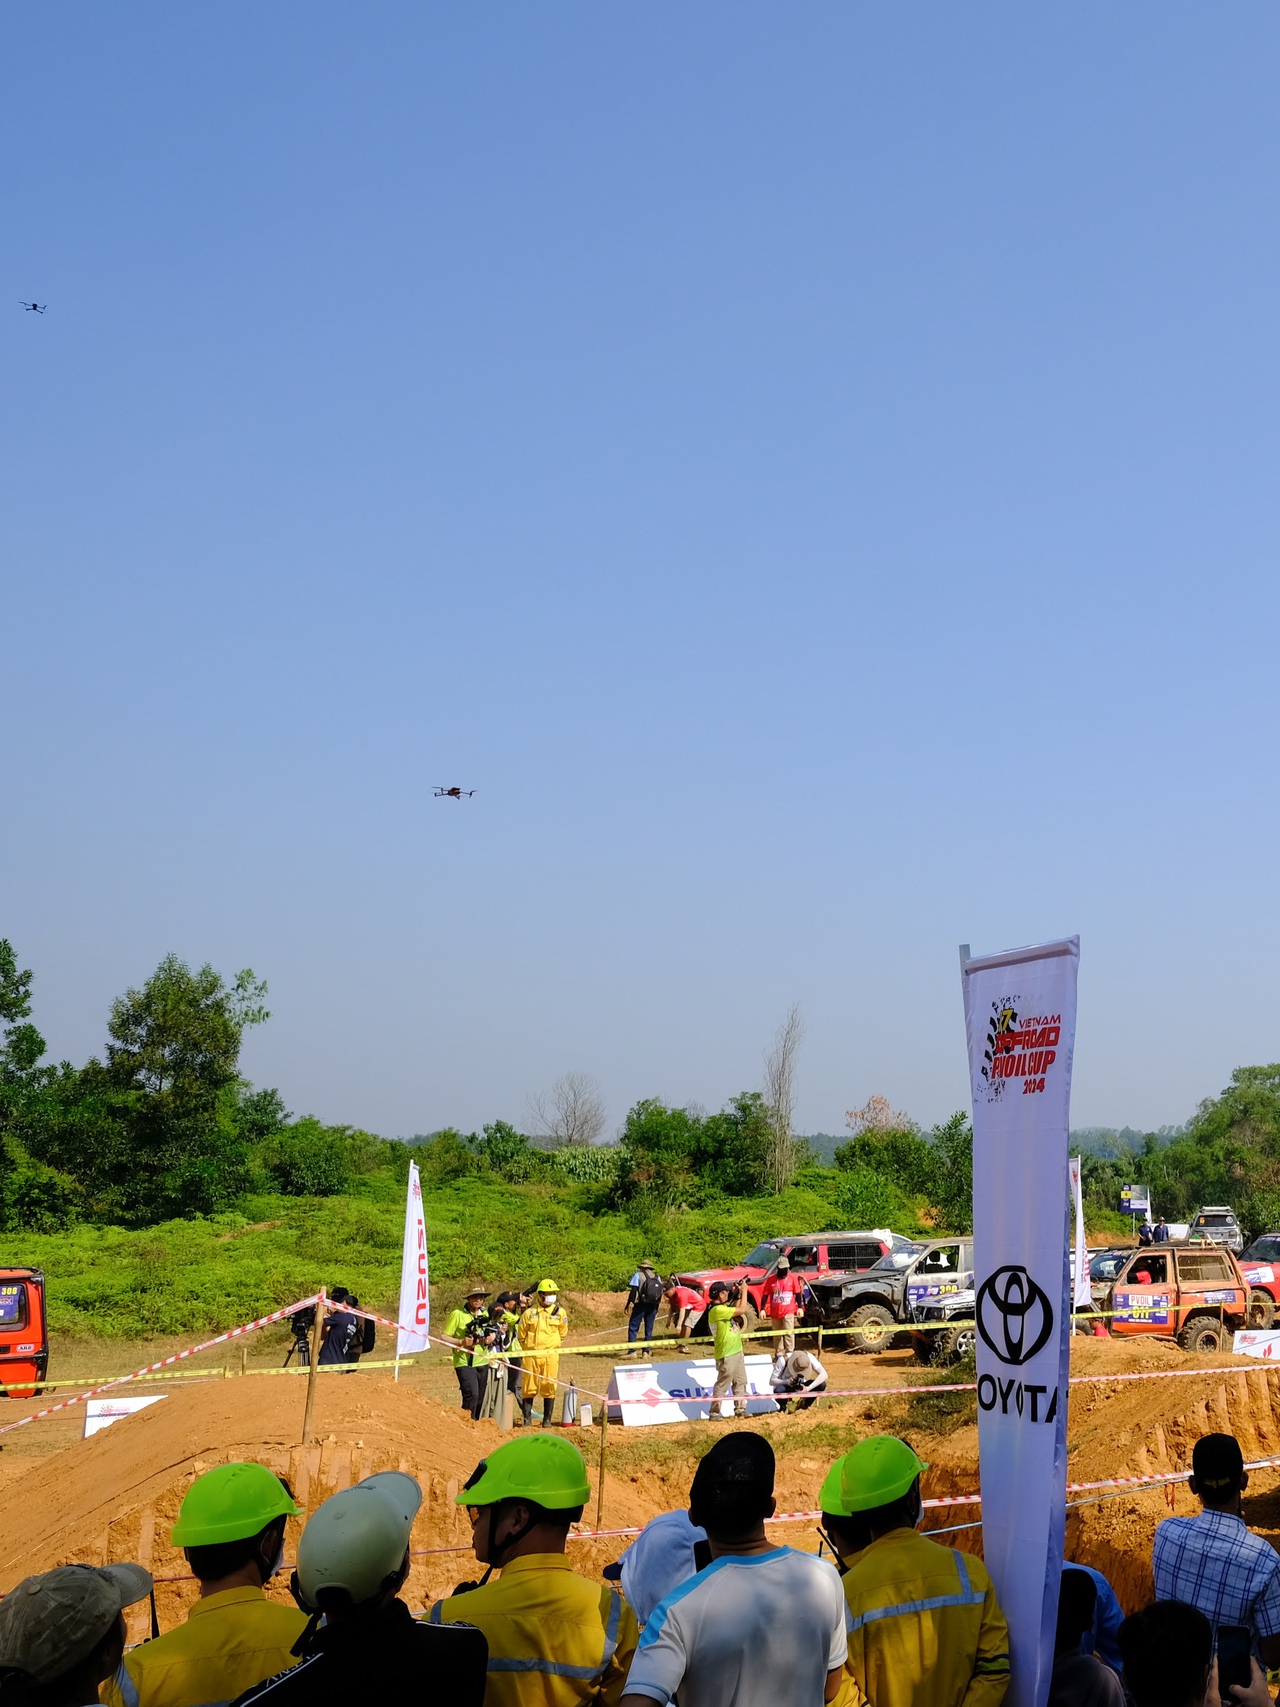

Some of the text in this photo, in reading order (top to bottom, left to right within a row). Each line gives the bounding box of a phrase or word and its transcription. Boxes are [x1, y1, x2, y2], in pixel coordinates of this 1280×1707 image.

[1019, 1014, 1061, 1029] VIETNAM
[1022, 1077, 1045, 1094] 2024
[415, 1218, 427, 1325] ISUZU
[1130, 1295, 1150, 1305] PVOIL
[978, 1373, 1058, 1423] OYOTA
